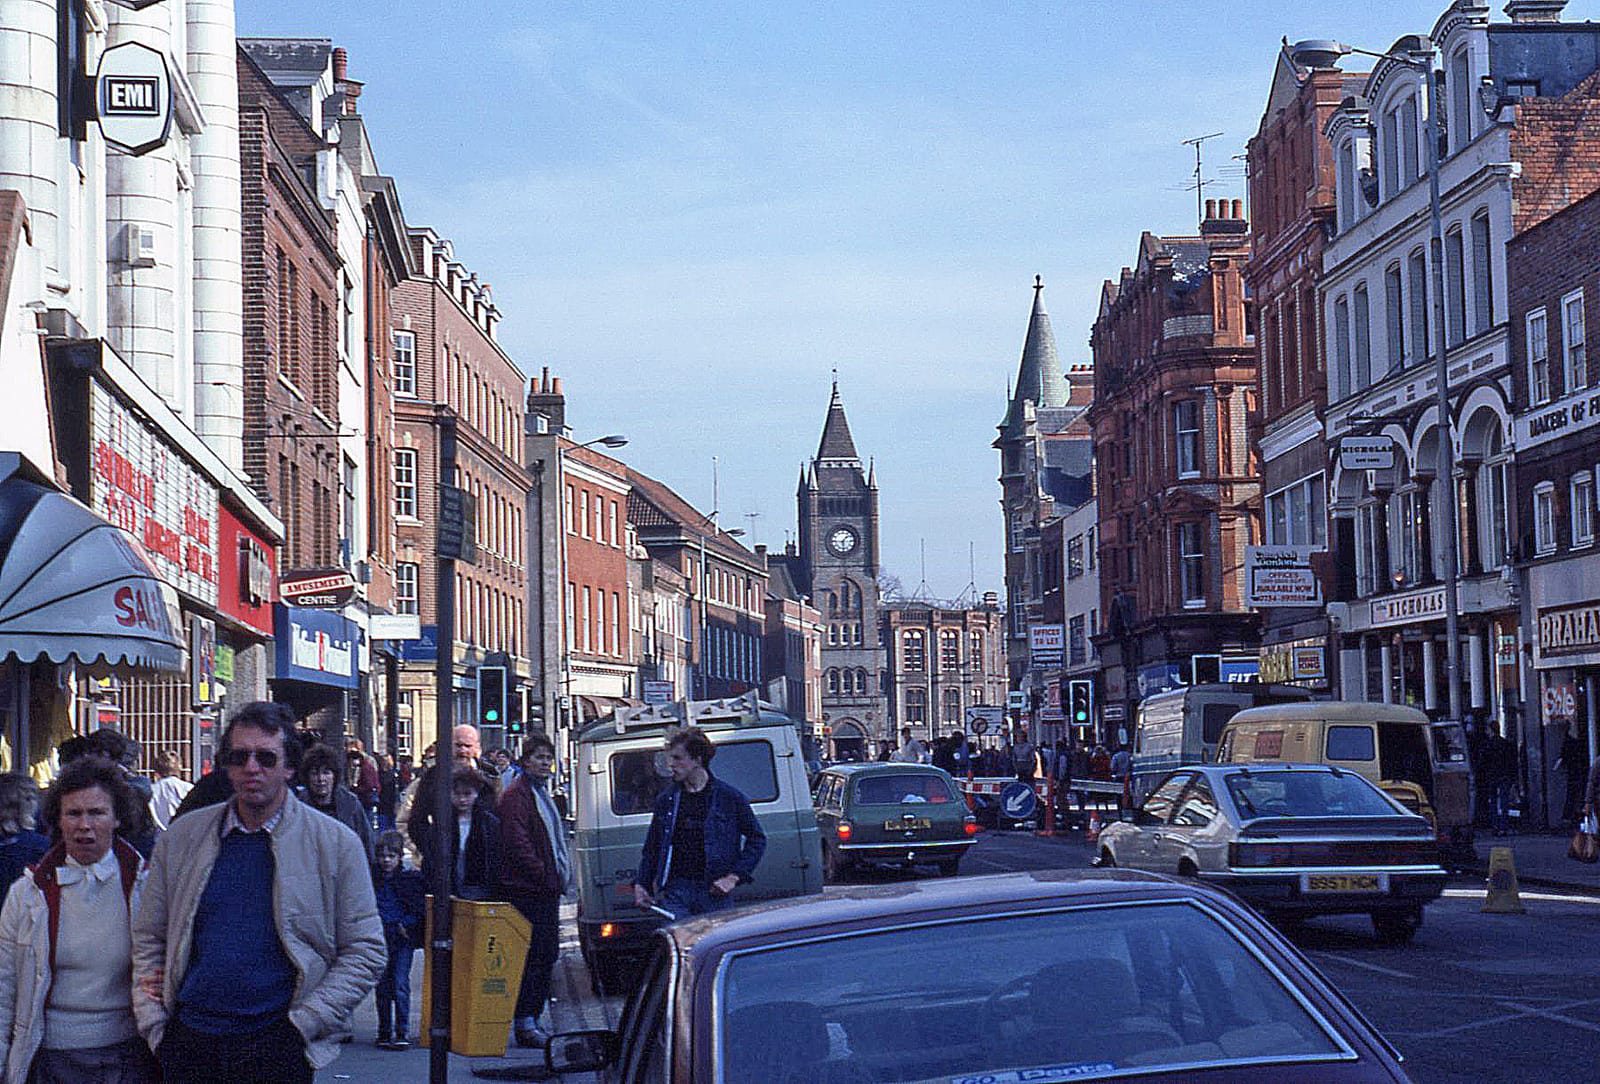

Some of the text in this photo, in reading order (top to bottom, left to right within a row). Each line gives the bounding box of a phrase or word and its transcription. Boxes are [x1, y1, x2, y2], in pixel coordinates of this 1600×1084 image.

[111, 84, 152, 107] EMI
[1572, 400, 1585, 422] OF
[286, 577, 346, 594] AMUSEMENT
[1295, 585, 1312, 593] NOW
[298, 595, 337, 605] CENTRE
[1388, 593, 1443, 618] NICHOLAS
[1036, 637, 1058, 645] TO LET
